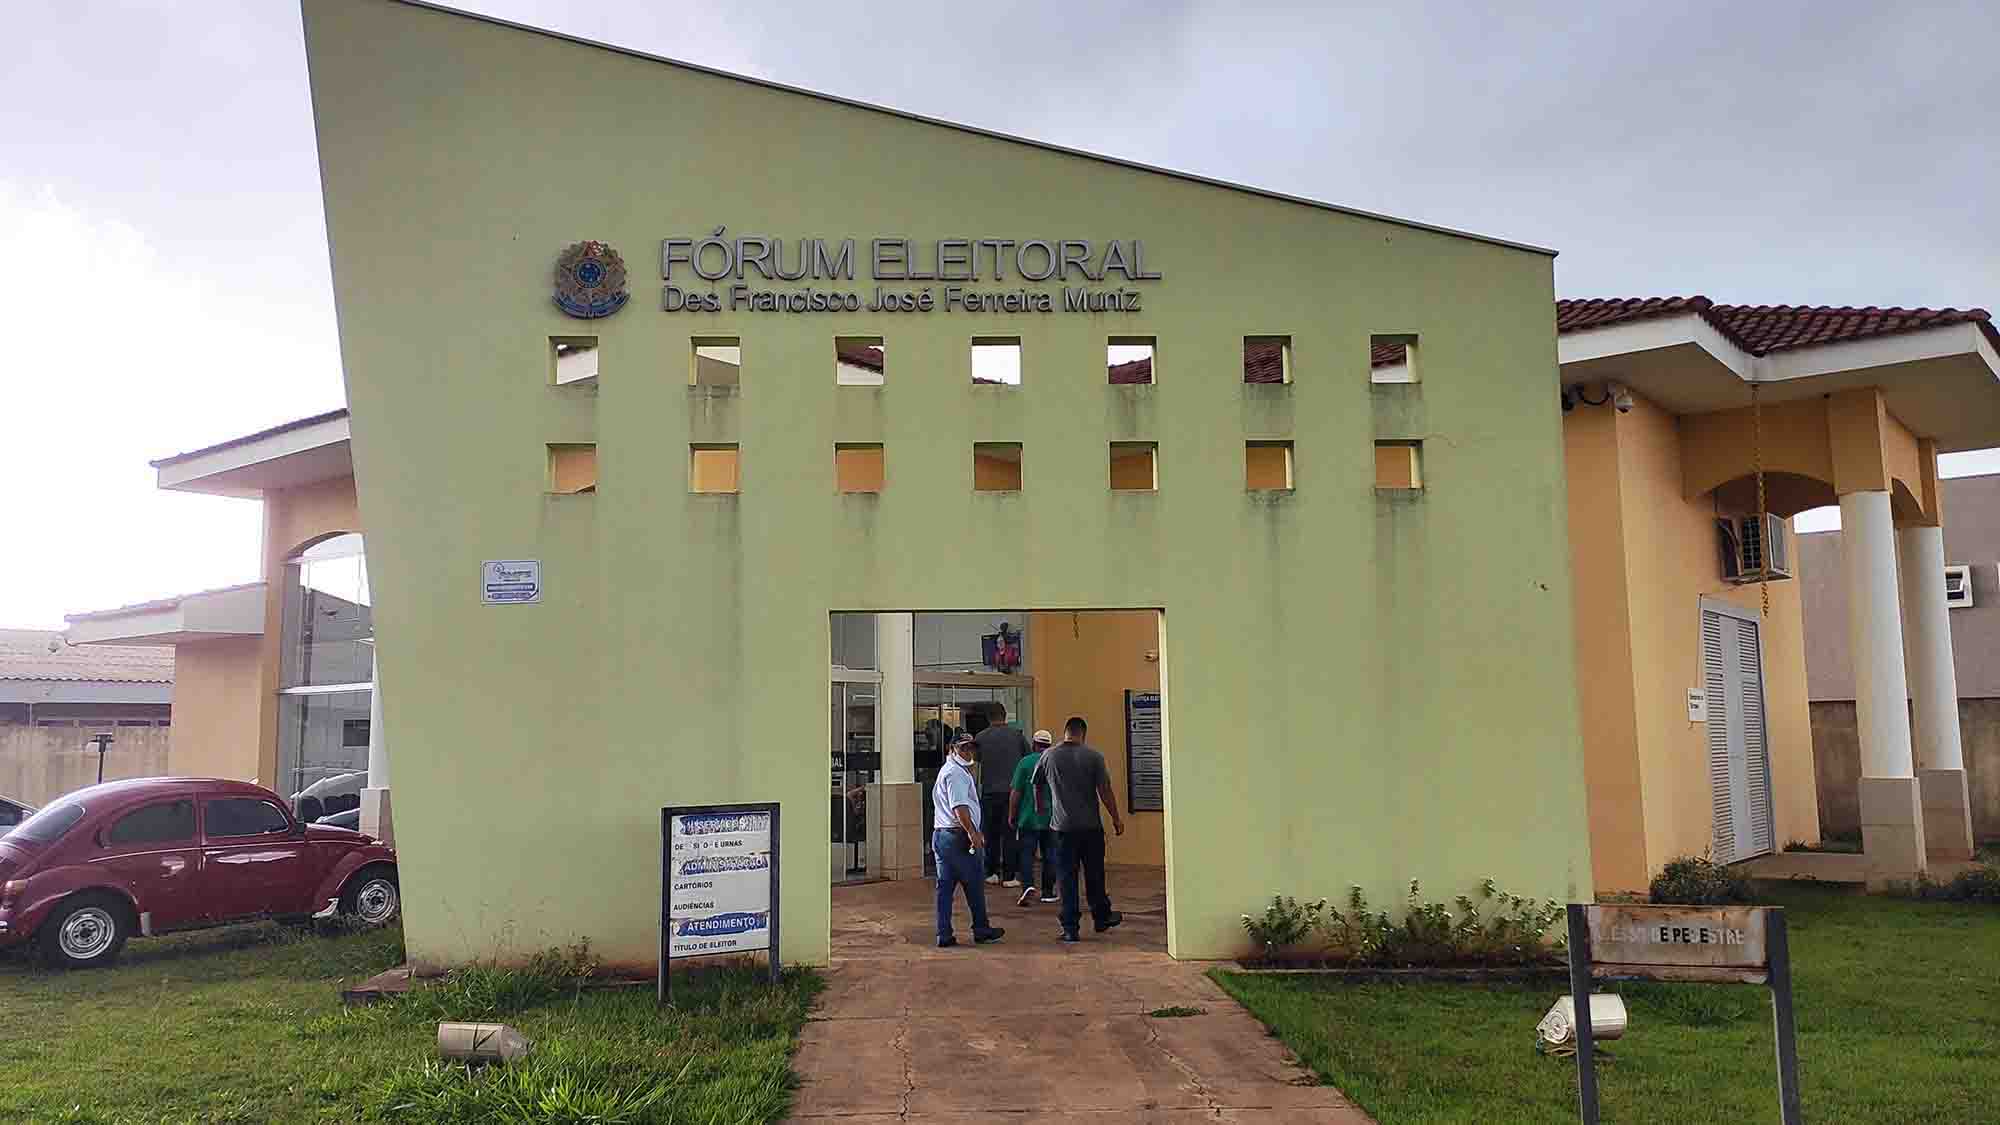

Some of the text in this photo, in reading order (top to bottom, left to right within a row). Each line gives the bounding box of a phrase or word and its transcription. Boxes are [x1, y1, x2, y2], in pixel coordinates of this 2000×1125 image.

[662, 224, 1162, 281] FÓRUM ELEITORAL
[663, 285, 1141, 312] Des. Francisco José Ferreira Muniz
[720, 840, 743, 848] URNAS
[687, 917, 755, 931] ATENDIMENTO
[710, 940, 737, 948] ELEITOR
